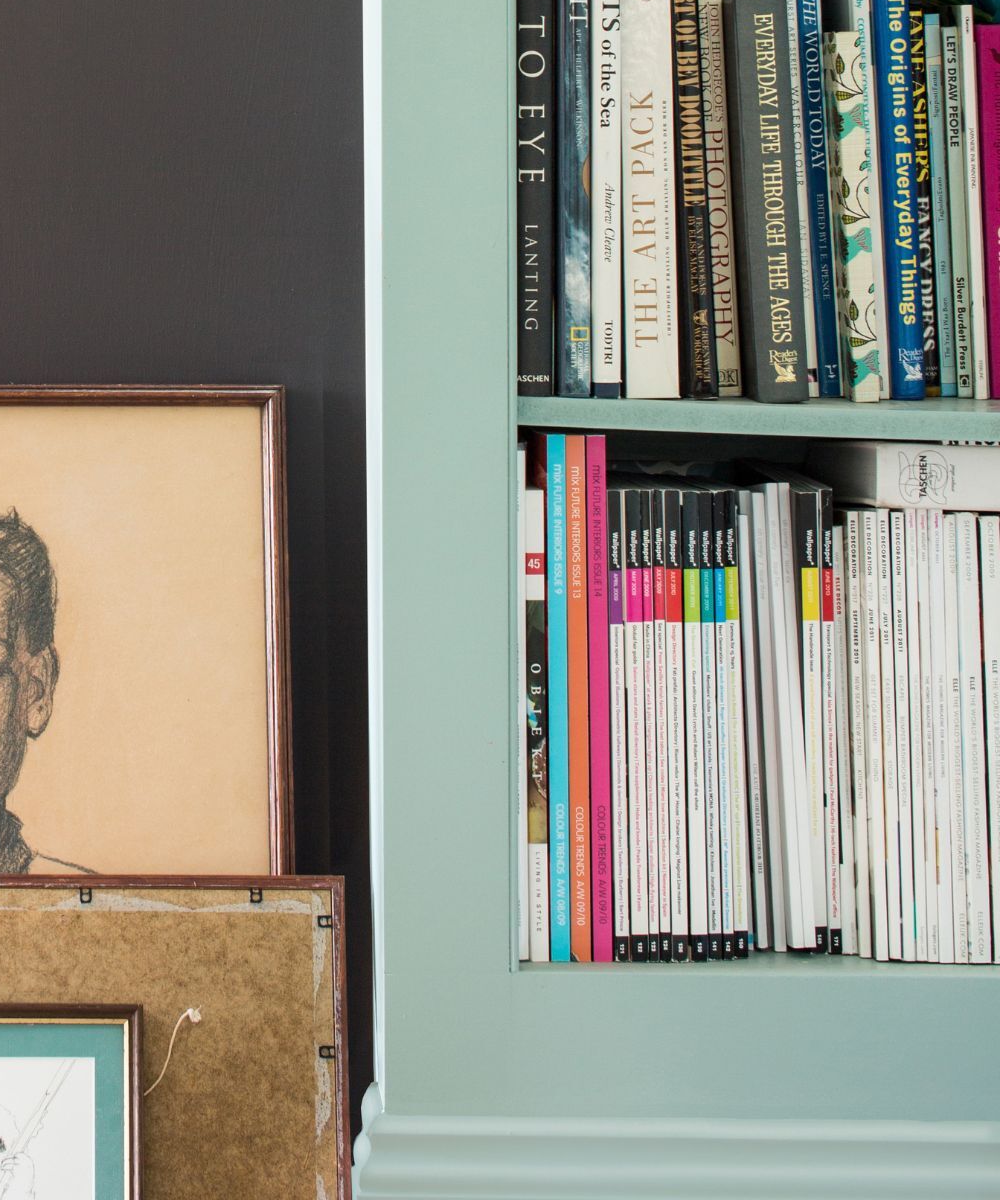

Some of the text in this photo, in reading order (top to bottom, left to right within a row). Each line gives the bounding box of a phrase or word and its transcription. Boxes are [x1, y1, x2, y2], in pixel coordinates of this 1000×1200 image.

[518, 16, 545, 78] TO
[600, 40, 615, 59] of
[675, 20, 698, 47] OF
[804, 30, 820, 103] WORLD
[601, 63, 614, 94] the
[677, 50, 700, 89] BEV
[889, 39, 909, 119] Origins
[946, 36, 959, 147] LET'S DRAW PEOPLE
[517, 104, 545, 183] EYE
[600, 98, 614, 127] Sea
[808, 106, 825, 170] TODAY
[894, 125, 911, 144] of
[679, 94, 706, 206] DOOLITTLE
[753, 13, 792, 343] EVERYDAY LIFE THROUGH THE AGES
[604, 183, 615, 262] Andrew Cleave
[630, 91, 659, 348] THE ART PACK
[893, 153, 917, 249] Everyday
[704, 128, 734, 346] PHOTOGRAPHY
[525, 225, 538, 330] LANTING
[900, 255, 918, 325] Things
[604, 321, 613, 364] TODTRI
[956, 277, 968, 370] Silver Burdett Press
[919, 456, 928, 497] TASCHEN
[528, 558, 541, 570] 45
[571, 467, 581, 598] mix FUTURE INTERIORS ISSUE 13
[576, 807, 584, 842] COLOUR
[576, 845, 584, 876] TRENDS
